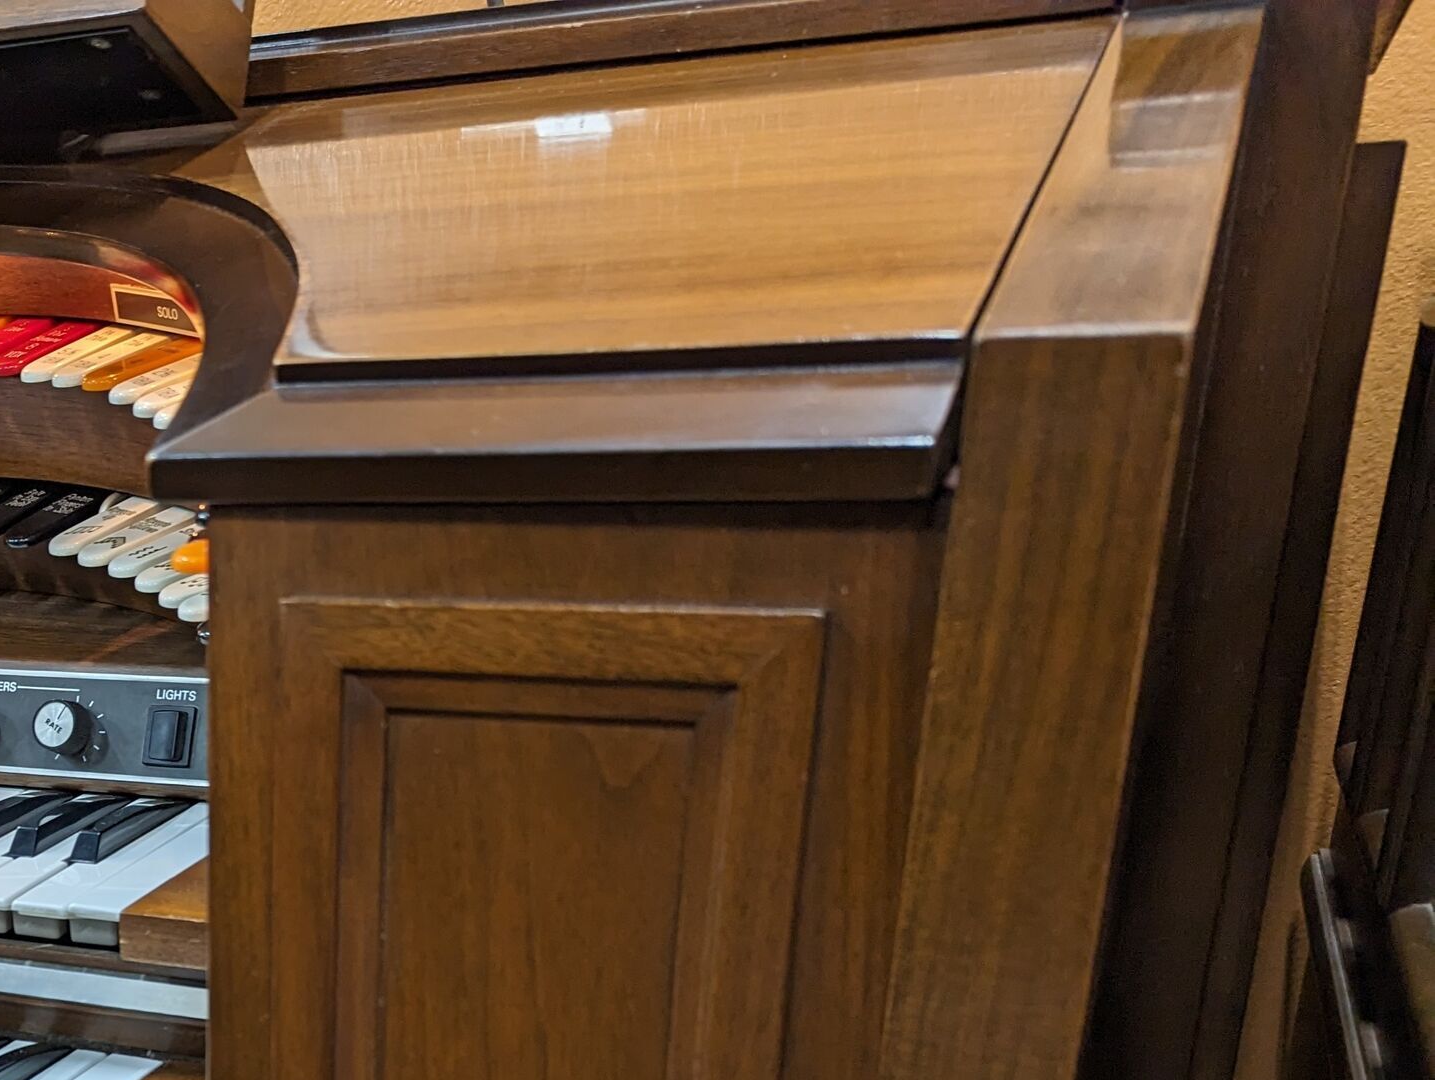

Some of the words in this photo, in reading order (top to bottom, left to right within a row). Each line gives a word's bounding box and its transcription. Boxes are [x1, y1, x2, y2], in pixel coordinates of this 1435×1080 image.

[156, 306, 179, 321] SOLO
[156, 689, 197, 702] LIGHTS
[45, 718, 63, 734] RATE
